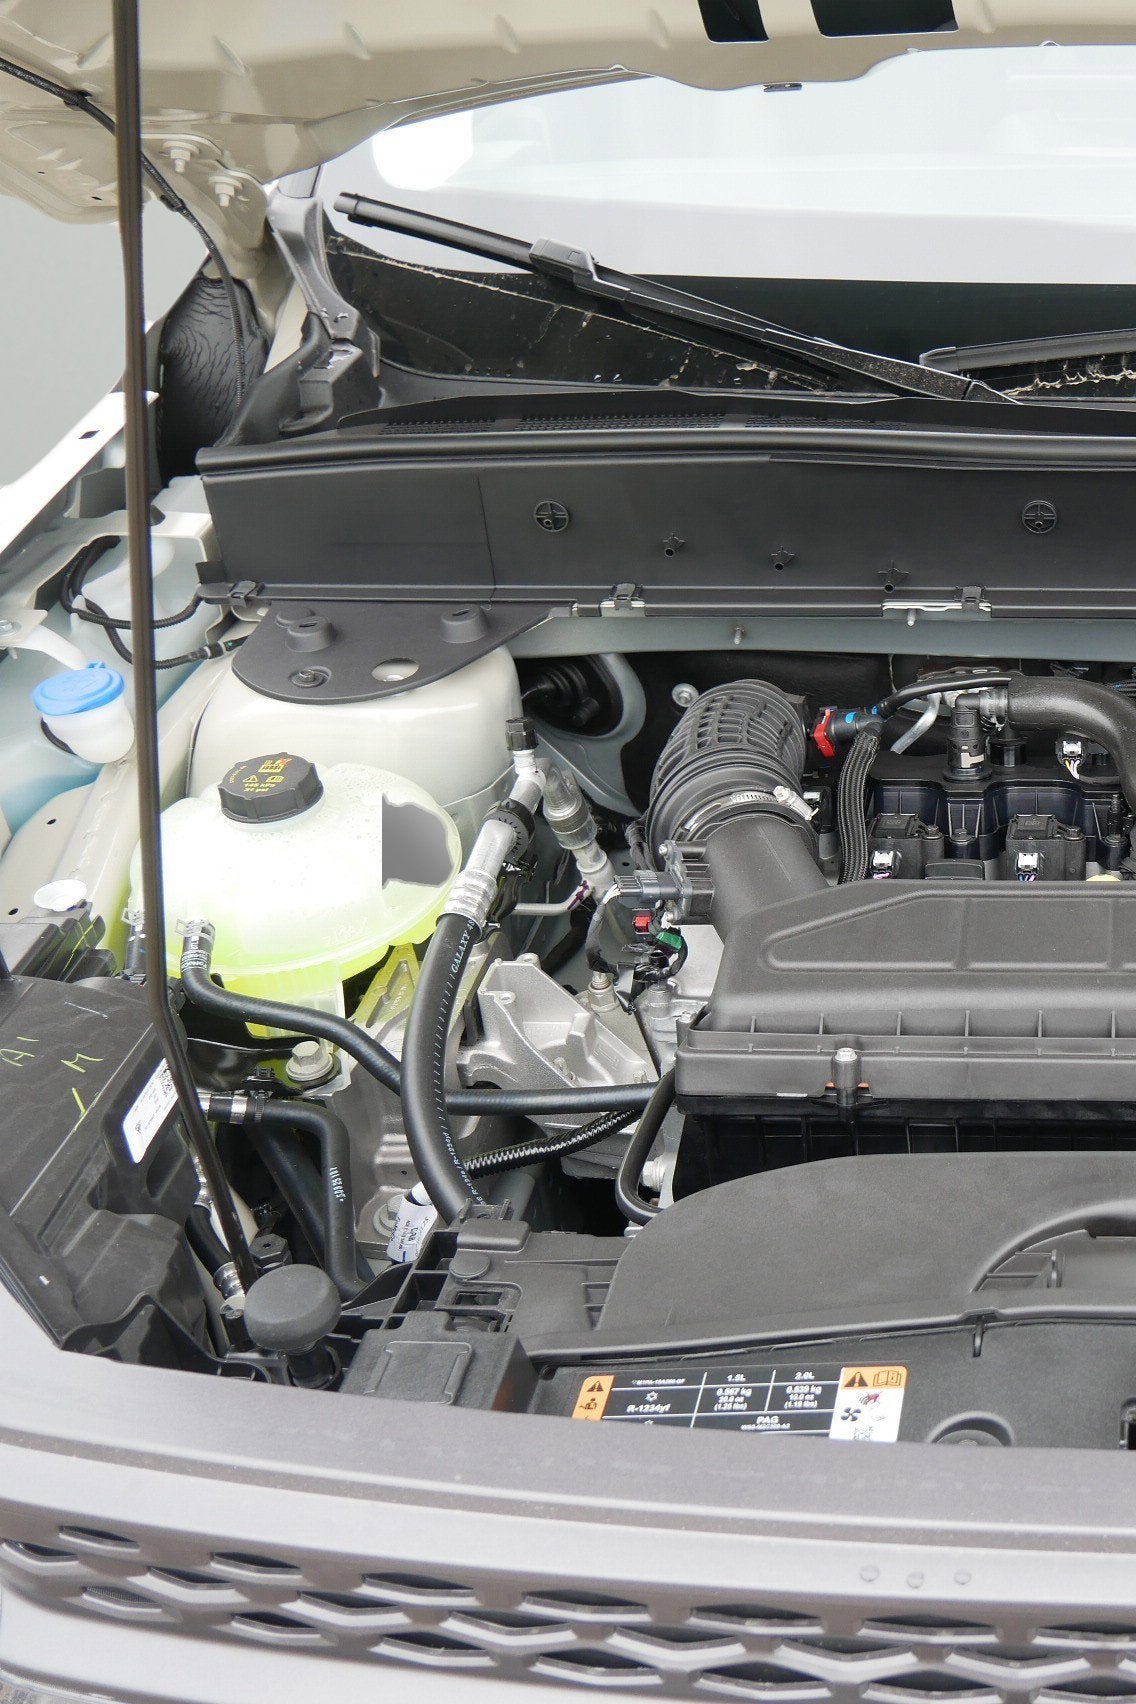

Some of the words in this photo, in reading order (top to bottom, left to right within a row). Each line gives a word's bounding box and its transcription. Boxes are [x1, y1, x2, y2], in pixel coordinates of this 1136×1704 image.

[451, 930, 470, 973] GALAXY
[794, 1371, 815, 1380] 2.0L
[740, 1387, 752, 1398] kg
[810, 1385, 822, 1395] kg
[626, 1403, 671, 1413] R-1234yf
[756, 1415, 779, 1424] PAG
